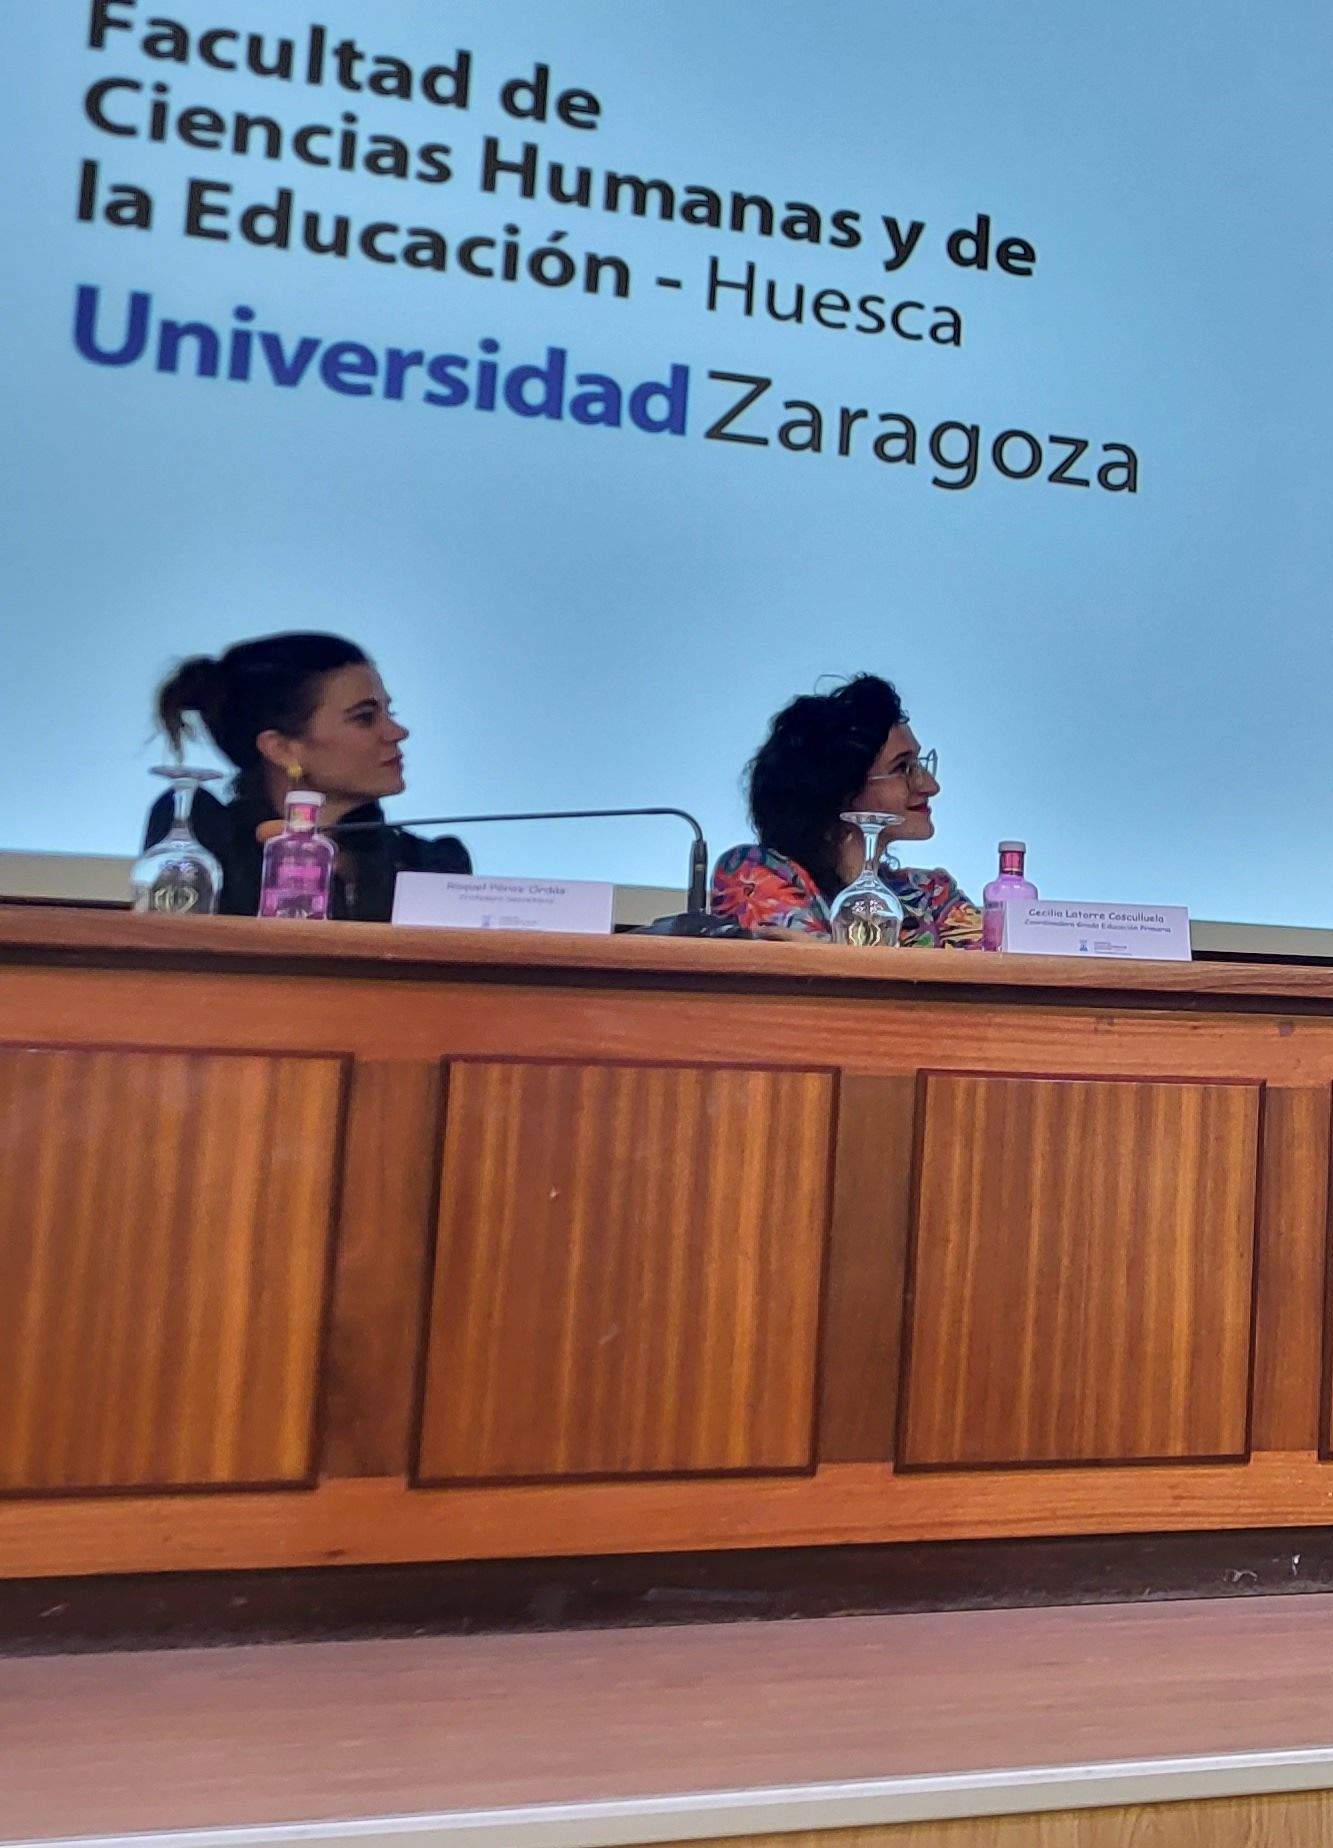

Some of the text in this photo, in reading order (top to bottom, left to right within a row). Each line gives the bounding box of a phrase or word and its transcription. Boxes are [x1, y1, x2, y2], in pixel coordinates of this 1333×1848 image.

[86, 0, 601, 130] Facultad de
[75, 159, 152, 231] la
[182, 178, 632, 300] Educación
[705, 256, 964, 348] Huesca
[82, 77, 1037, 277] Ciencias Humanas y de
[71, 284, 1140, 494] Universidad Zaragoza
[1028, 908, 1164, 923] Cecilia Latorre Cosculluela
